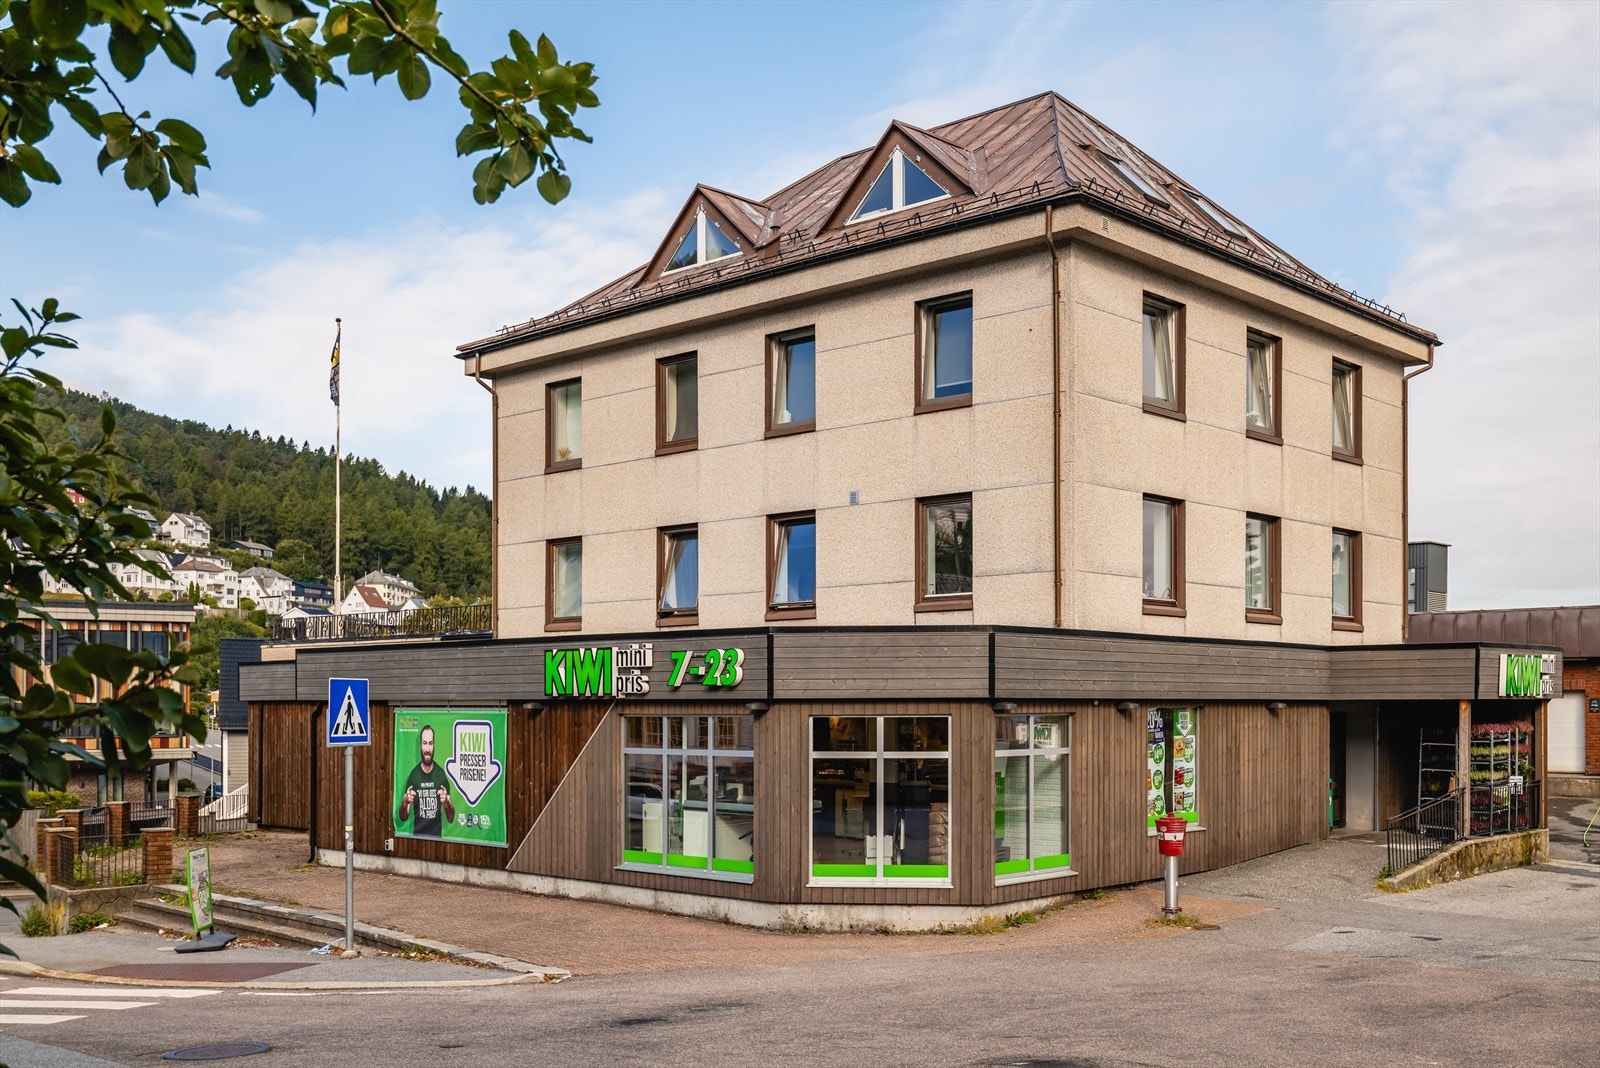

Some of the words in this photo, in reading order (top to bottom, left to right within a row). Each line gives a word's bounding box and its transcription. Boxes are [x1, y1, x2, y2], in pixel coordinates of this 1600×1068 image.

[616, 644, 651, 667] mini
[544, 647, 613, 697] KIWI
[667, 648, 743, 688] 7-23
[1505, 654, 1541, 696] KIWI
[616, 669, 648, 698] pris
[1541, 677, 1554, 695] pris
[460, 732, 486, 752] KIWI
[460, 754, 487, 767] PRESSER
[460, 768, 487, 782] PRISENE!
[419, 797, 437, 810] ALDRI
